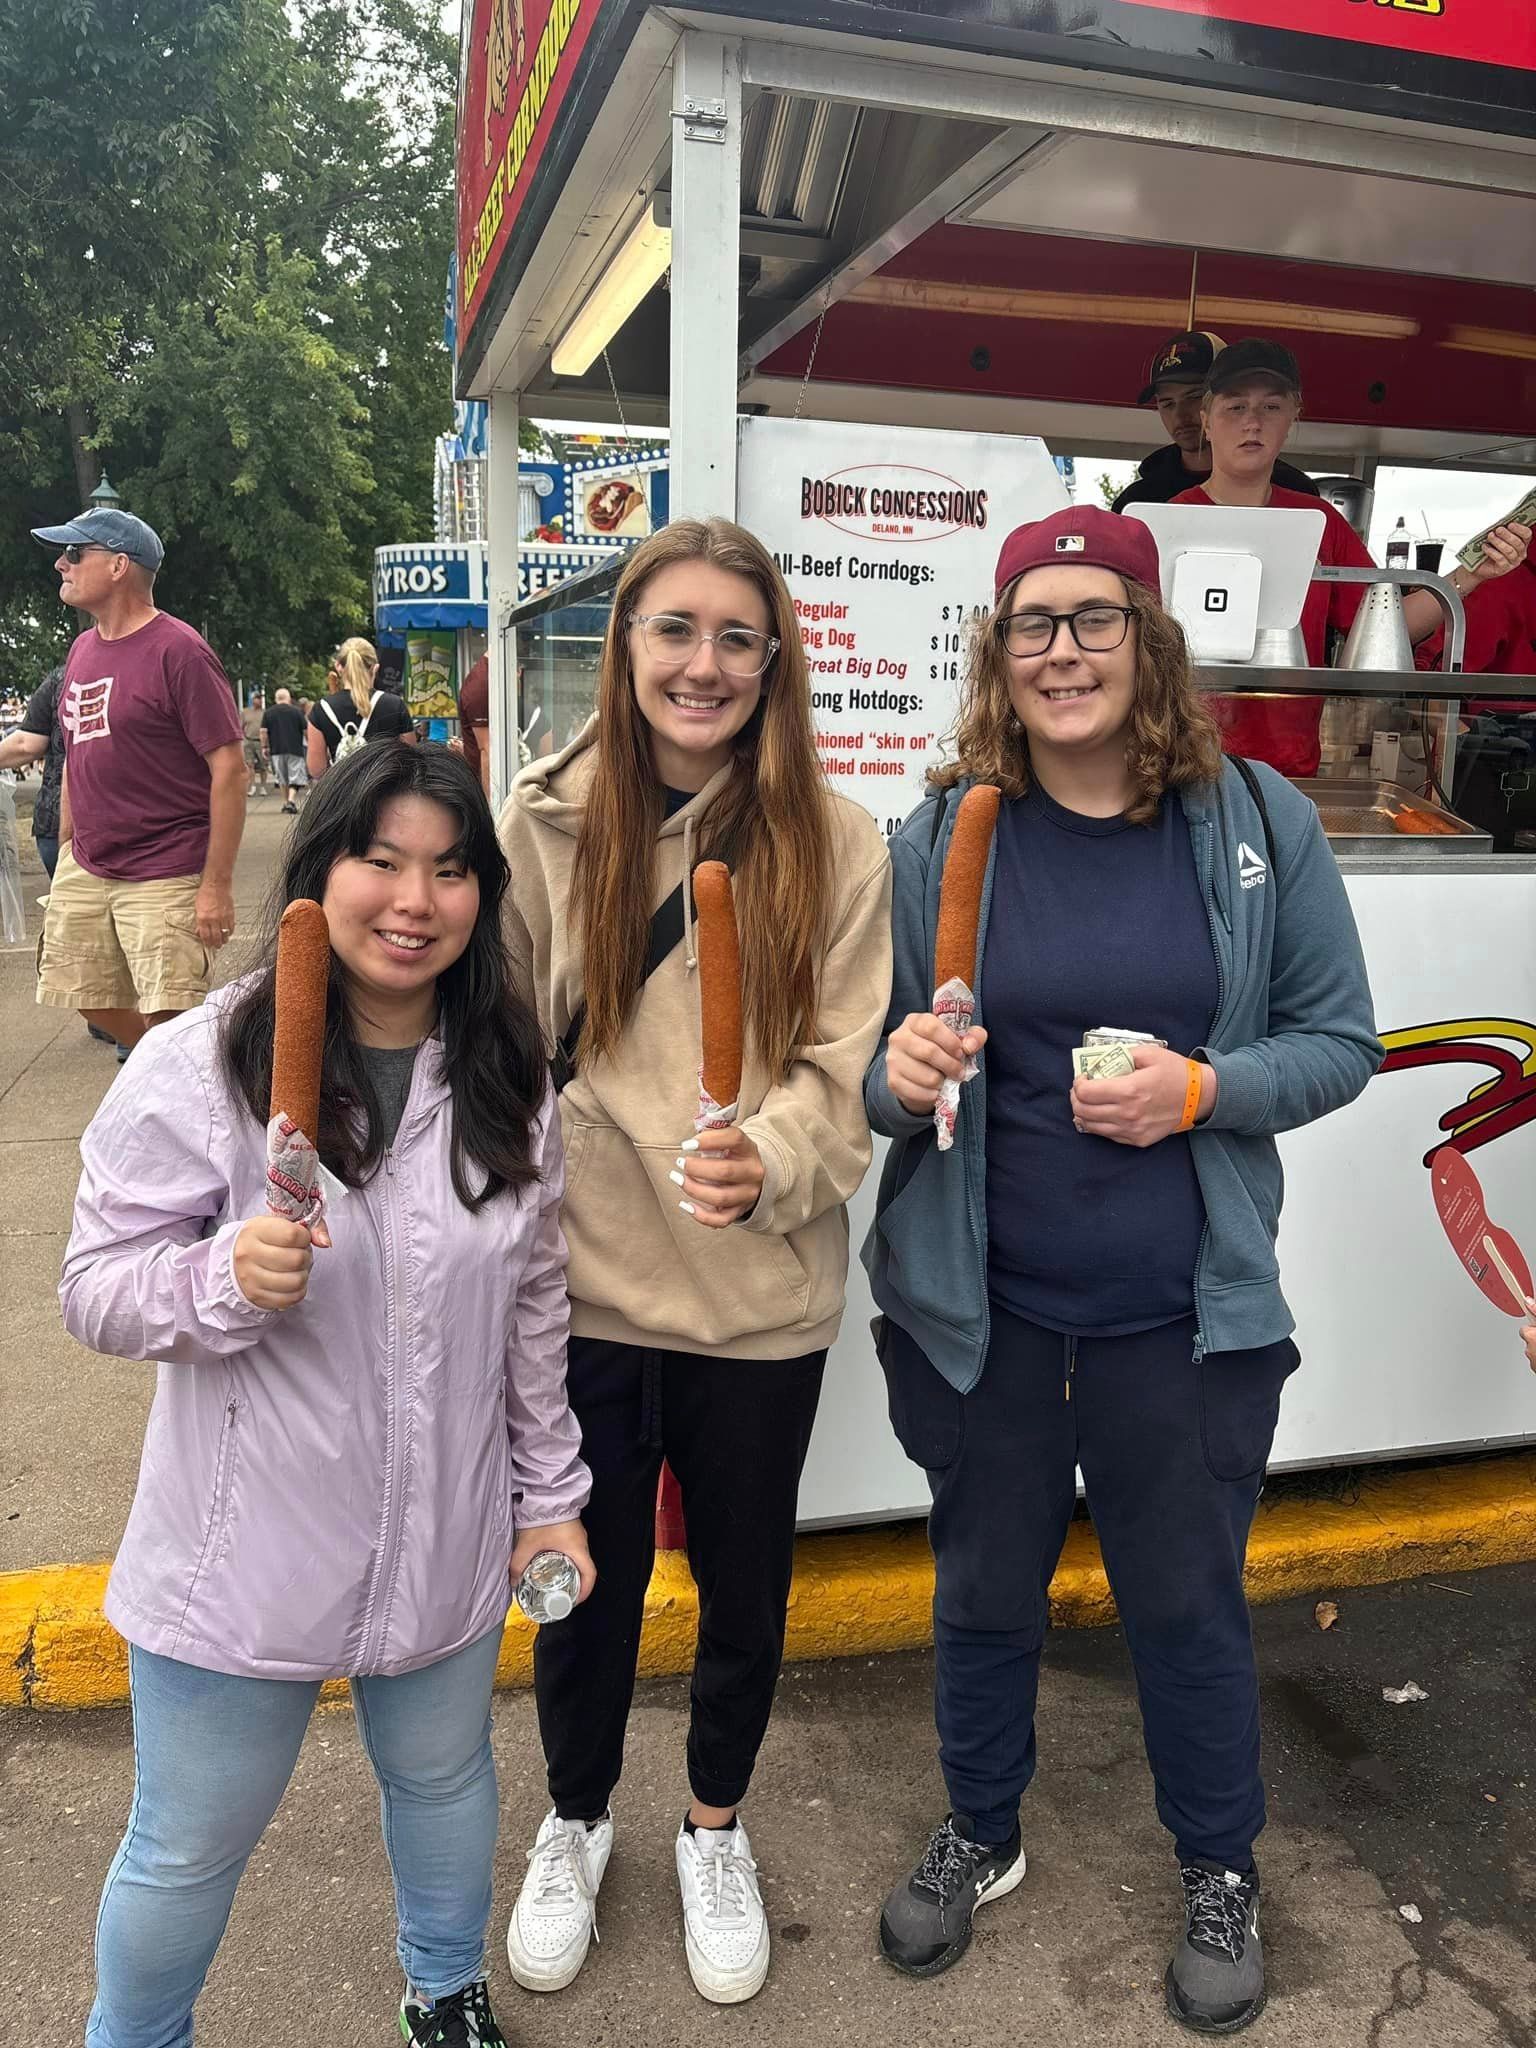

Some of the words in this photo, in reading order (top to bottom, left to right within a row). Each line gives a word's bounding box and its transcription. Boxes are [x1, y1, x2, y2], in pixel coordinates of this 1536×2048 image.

[507, 0, 580, 193] CORNDOG
[801, 477, 867, 519] BOBICK
[870, 488, 988, 528] CONCESSIONS
[872, 523, 901, 535] DELANO,
[902, 525, 914, 534] MN
[848, 557, 935, 585] Corndogs:
[794, 599, 849, 621] Regular
[800, 627, 823, 648] Big
[828, 629, 856, 649] Dog
[846, 658, 872, 678] Big
[876, 659, 907, 679] Dog
[812, 692, 843, 712] ong
[849, 689, 923, 714] Hotdogs:
[815, 731, 863, 749] hioned
[860, 758, 905, 775] onions
